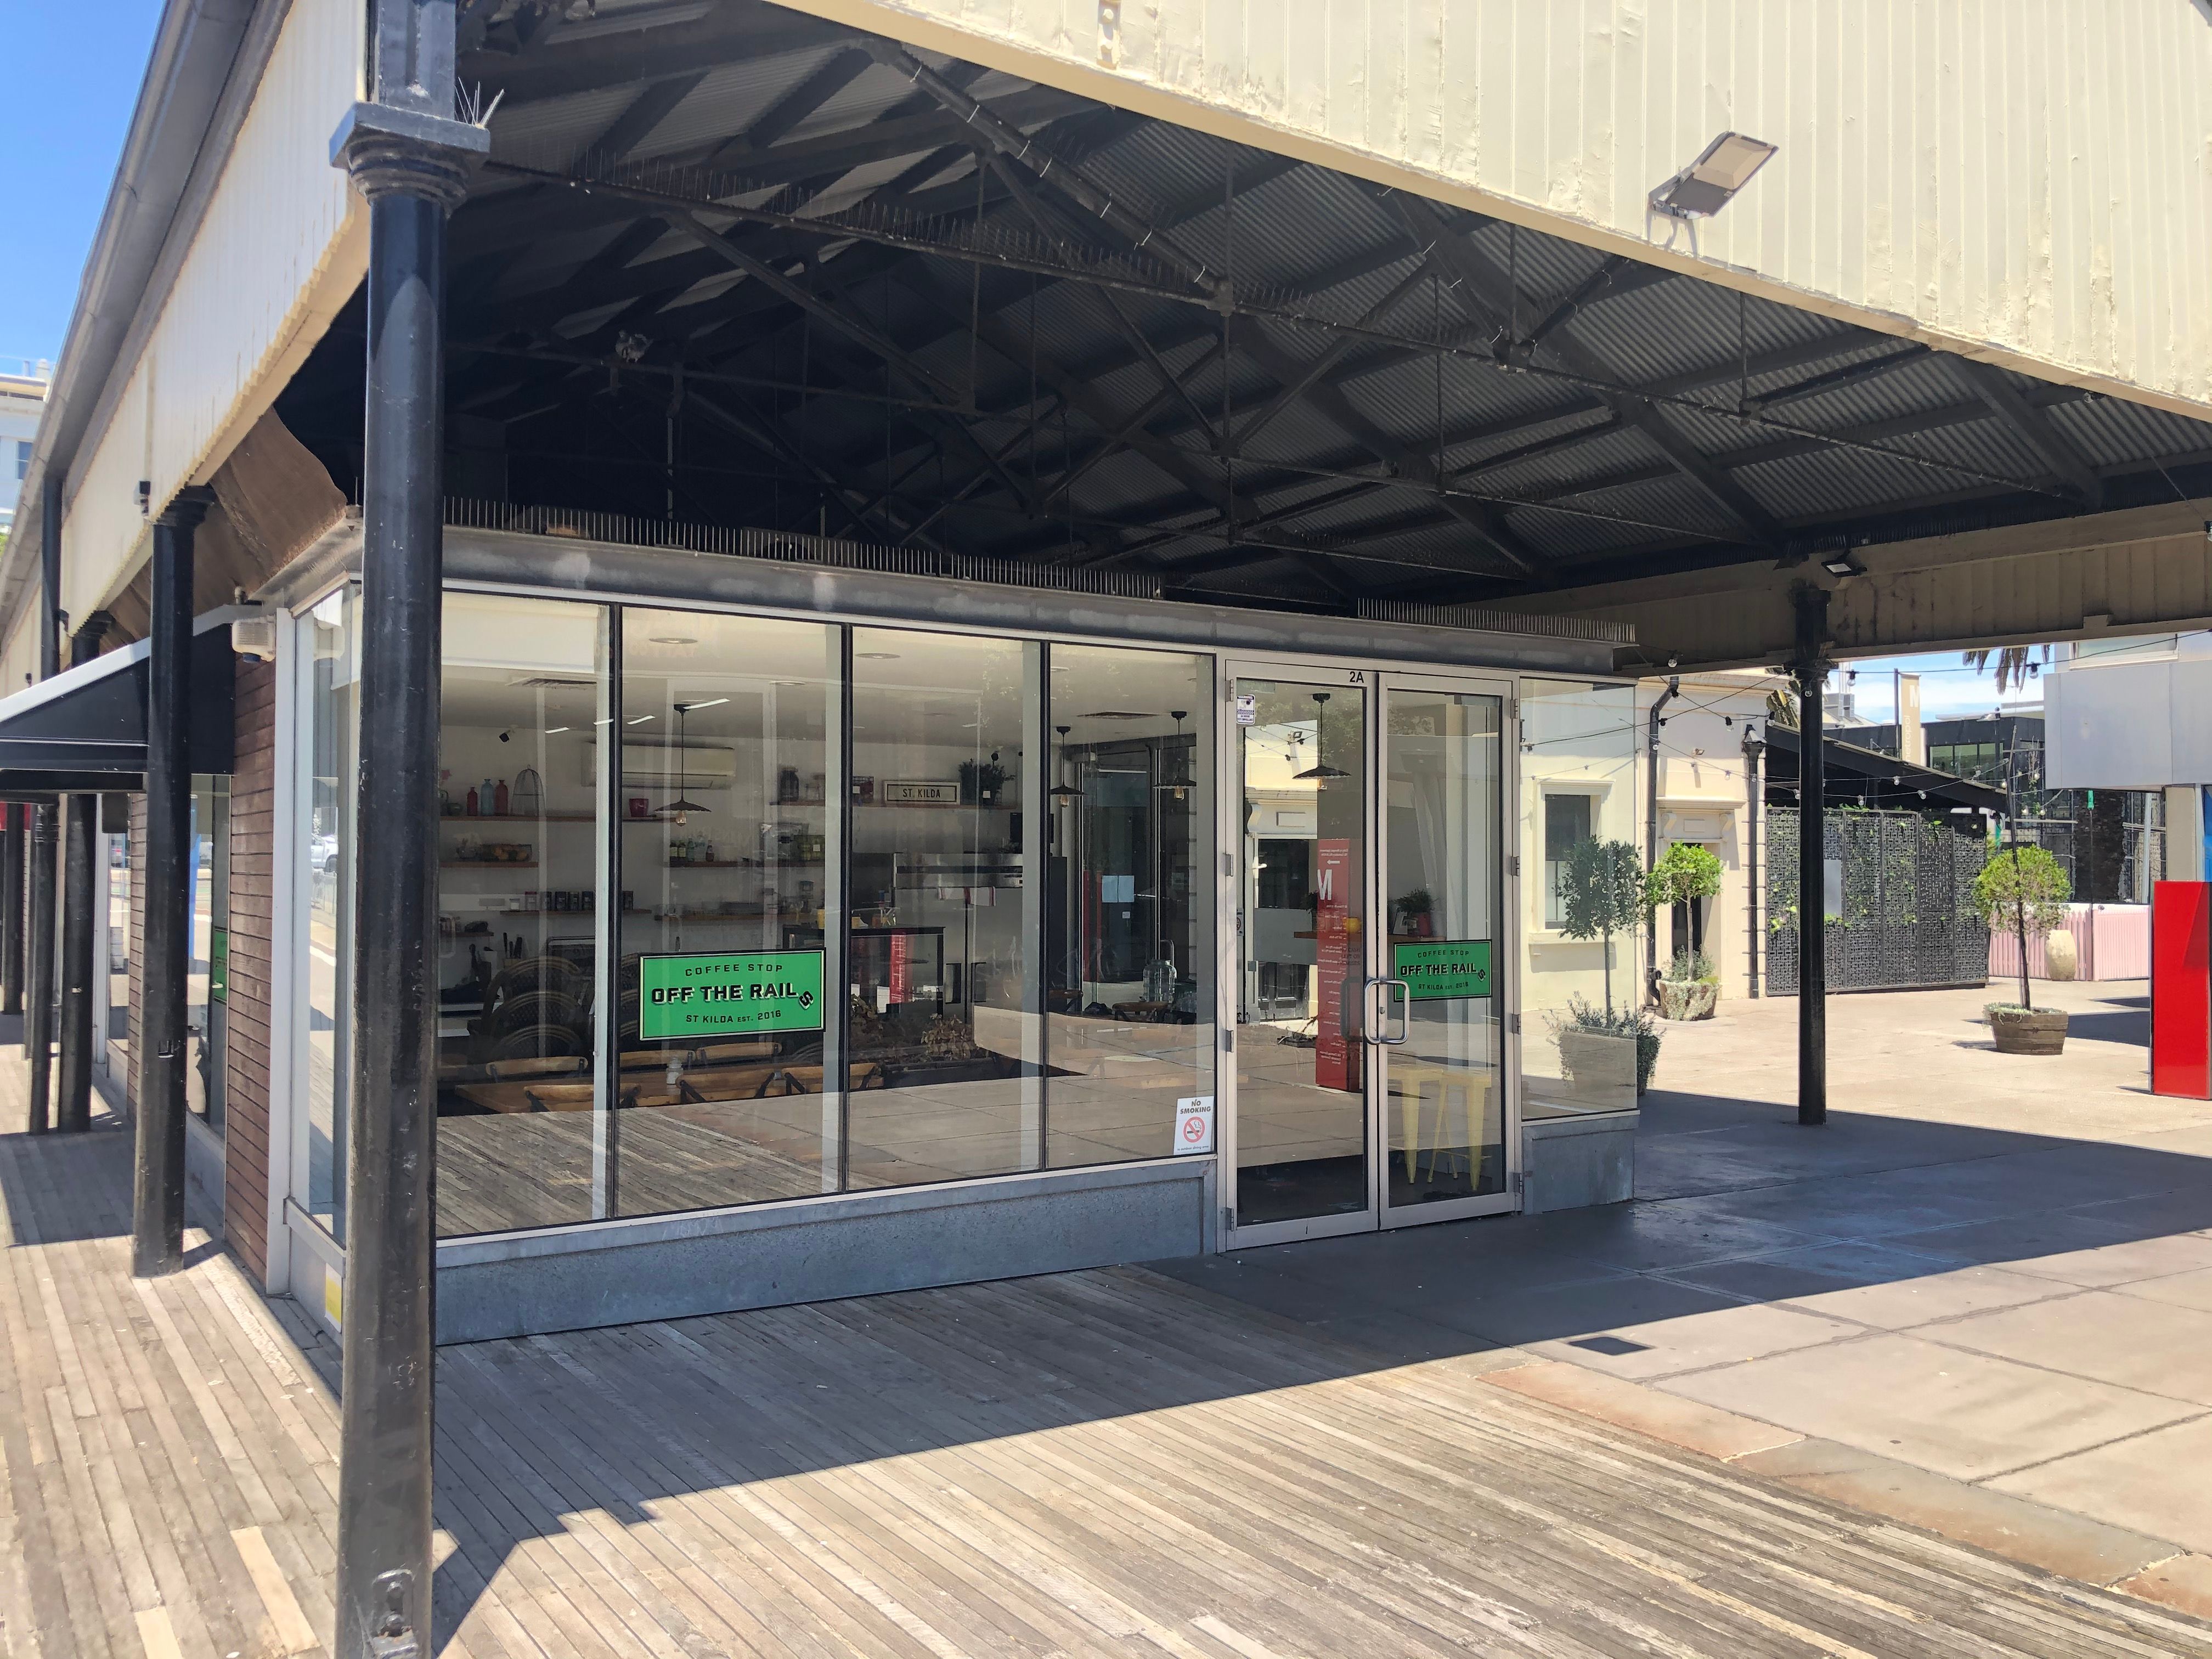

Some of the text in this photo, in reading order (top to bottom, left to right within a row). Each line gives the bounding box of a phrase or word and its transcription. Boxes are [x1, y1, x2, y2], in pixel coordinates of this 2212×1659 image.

[1350, 671, 1364, 683] 2A
[918, 789, 941, 798] KILDA
[1418, 950, 1446, 958] COFFEE
[685, 963, 783, 977] COFFEE STOP
[1401, 964, 1423, 977] OFF
[1426, 963, 1448, 975] THE
[651, 982, 814, 1009] OFF THE RAILS
[686, 1014, 699, 1023] ST
[703, 1015, 733, 1023] KILDA
[758, 1009, 782, 1020] 2016
[1180, 1106, 1211, 1114] SMOKING
